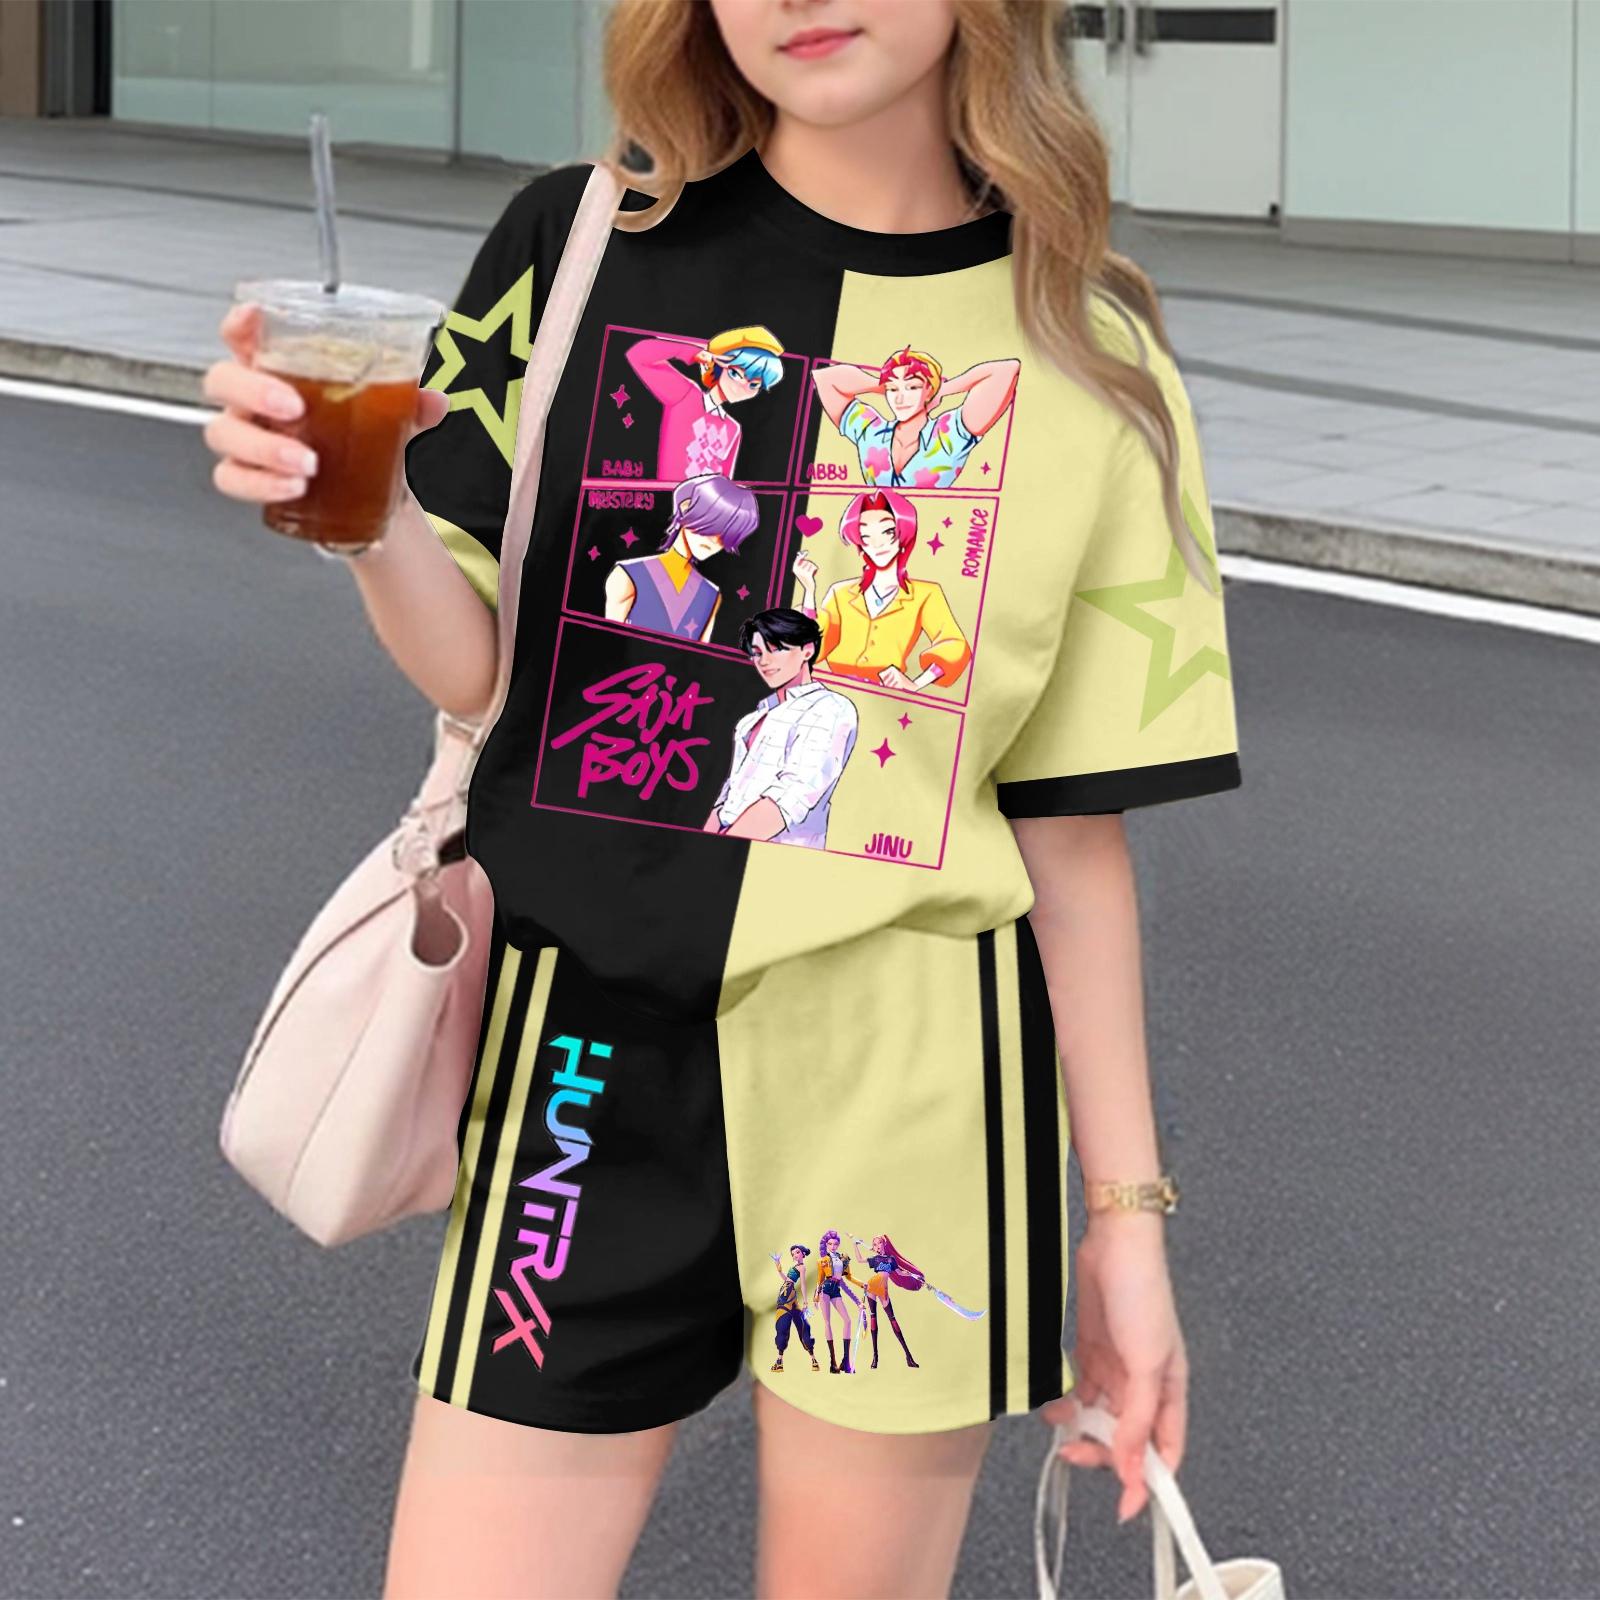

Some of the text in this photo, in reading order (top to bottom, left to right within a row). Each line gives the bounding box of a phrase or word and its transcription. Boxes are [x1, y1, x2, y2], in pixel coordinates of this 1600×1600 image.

[602, 460, 643, 477] BABY
[807, 463, 848, 480] ABBY
[577, 732, 710, 800] BOYS
